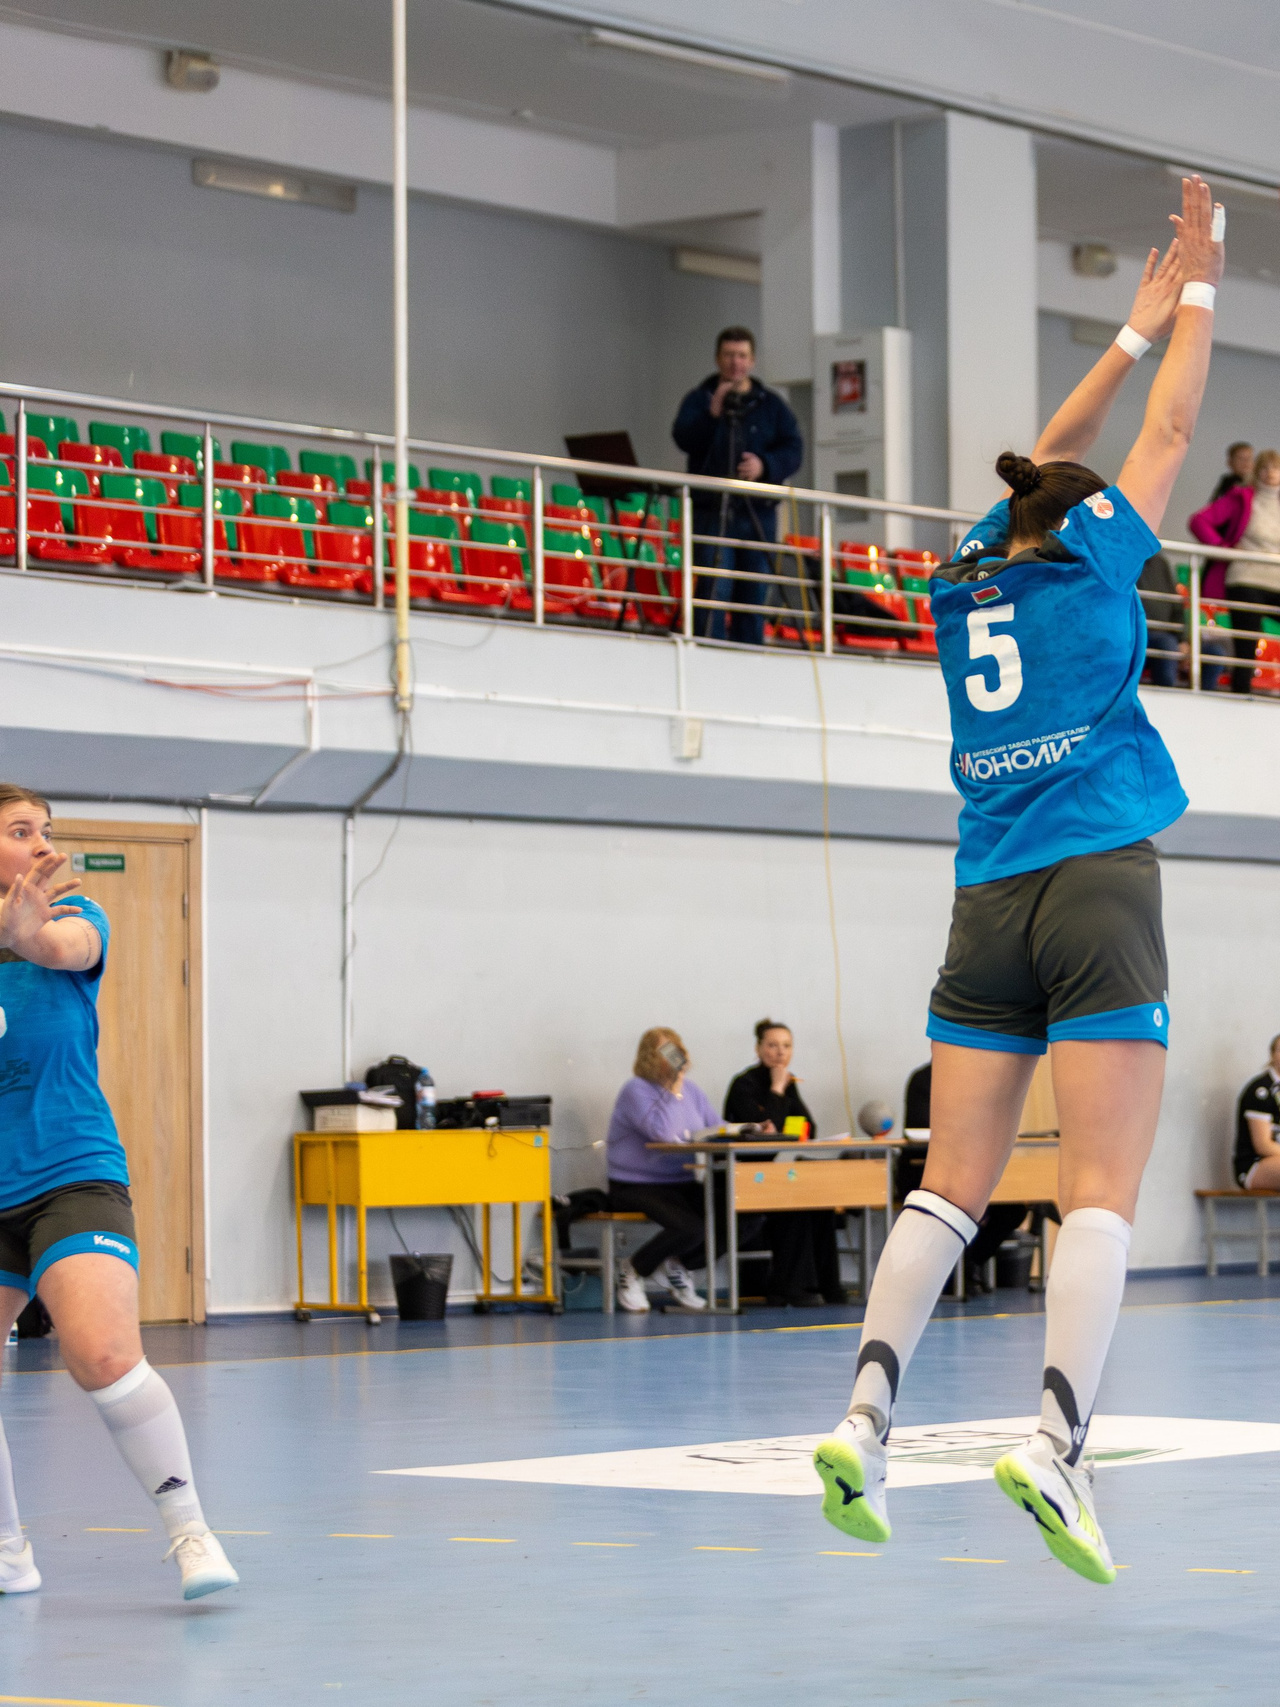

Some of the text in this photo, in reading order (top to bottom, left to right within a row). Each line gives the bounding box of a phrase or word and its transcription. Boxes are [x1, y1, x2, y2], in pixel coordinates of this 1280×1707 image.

[965, 603, 1023, 713] 5
[1008, 739, 1032, 750] ЗАВОД
[1032, 725, 1091, 745] РАДИОДЕТАЛЕЙ
